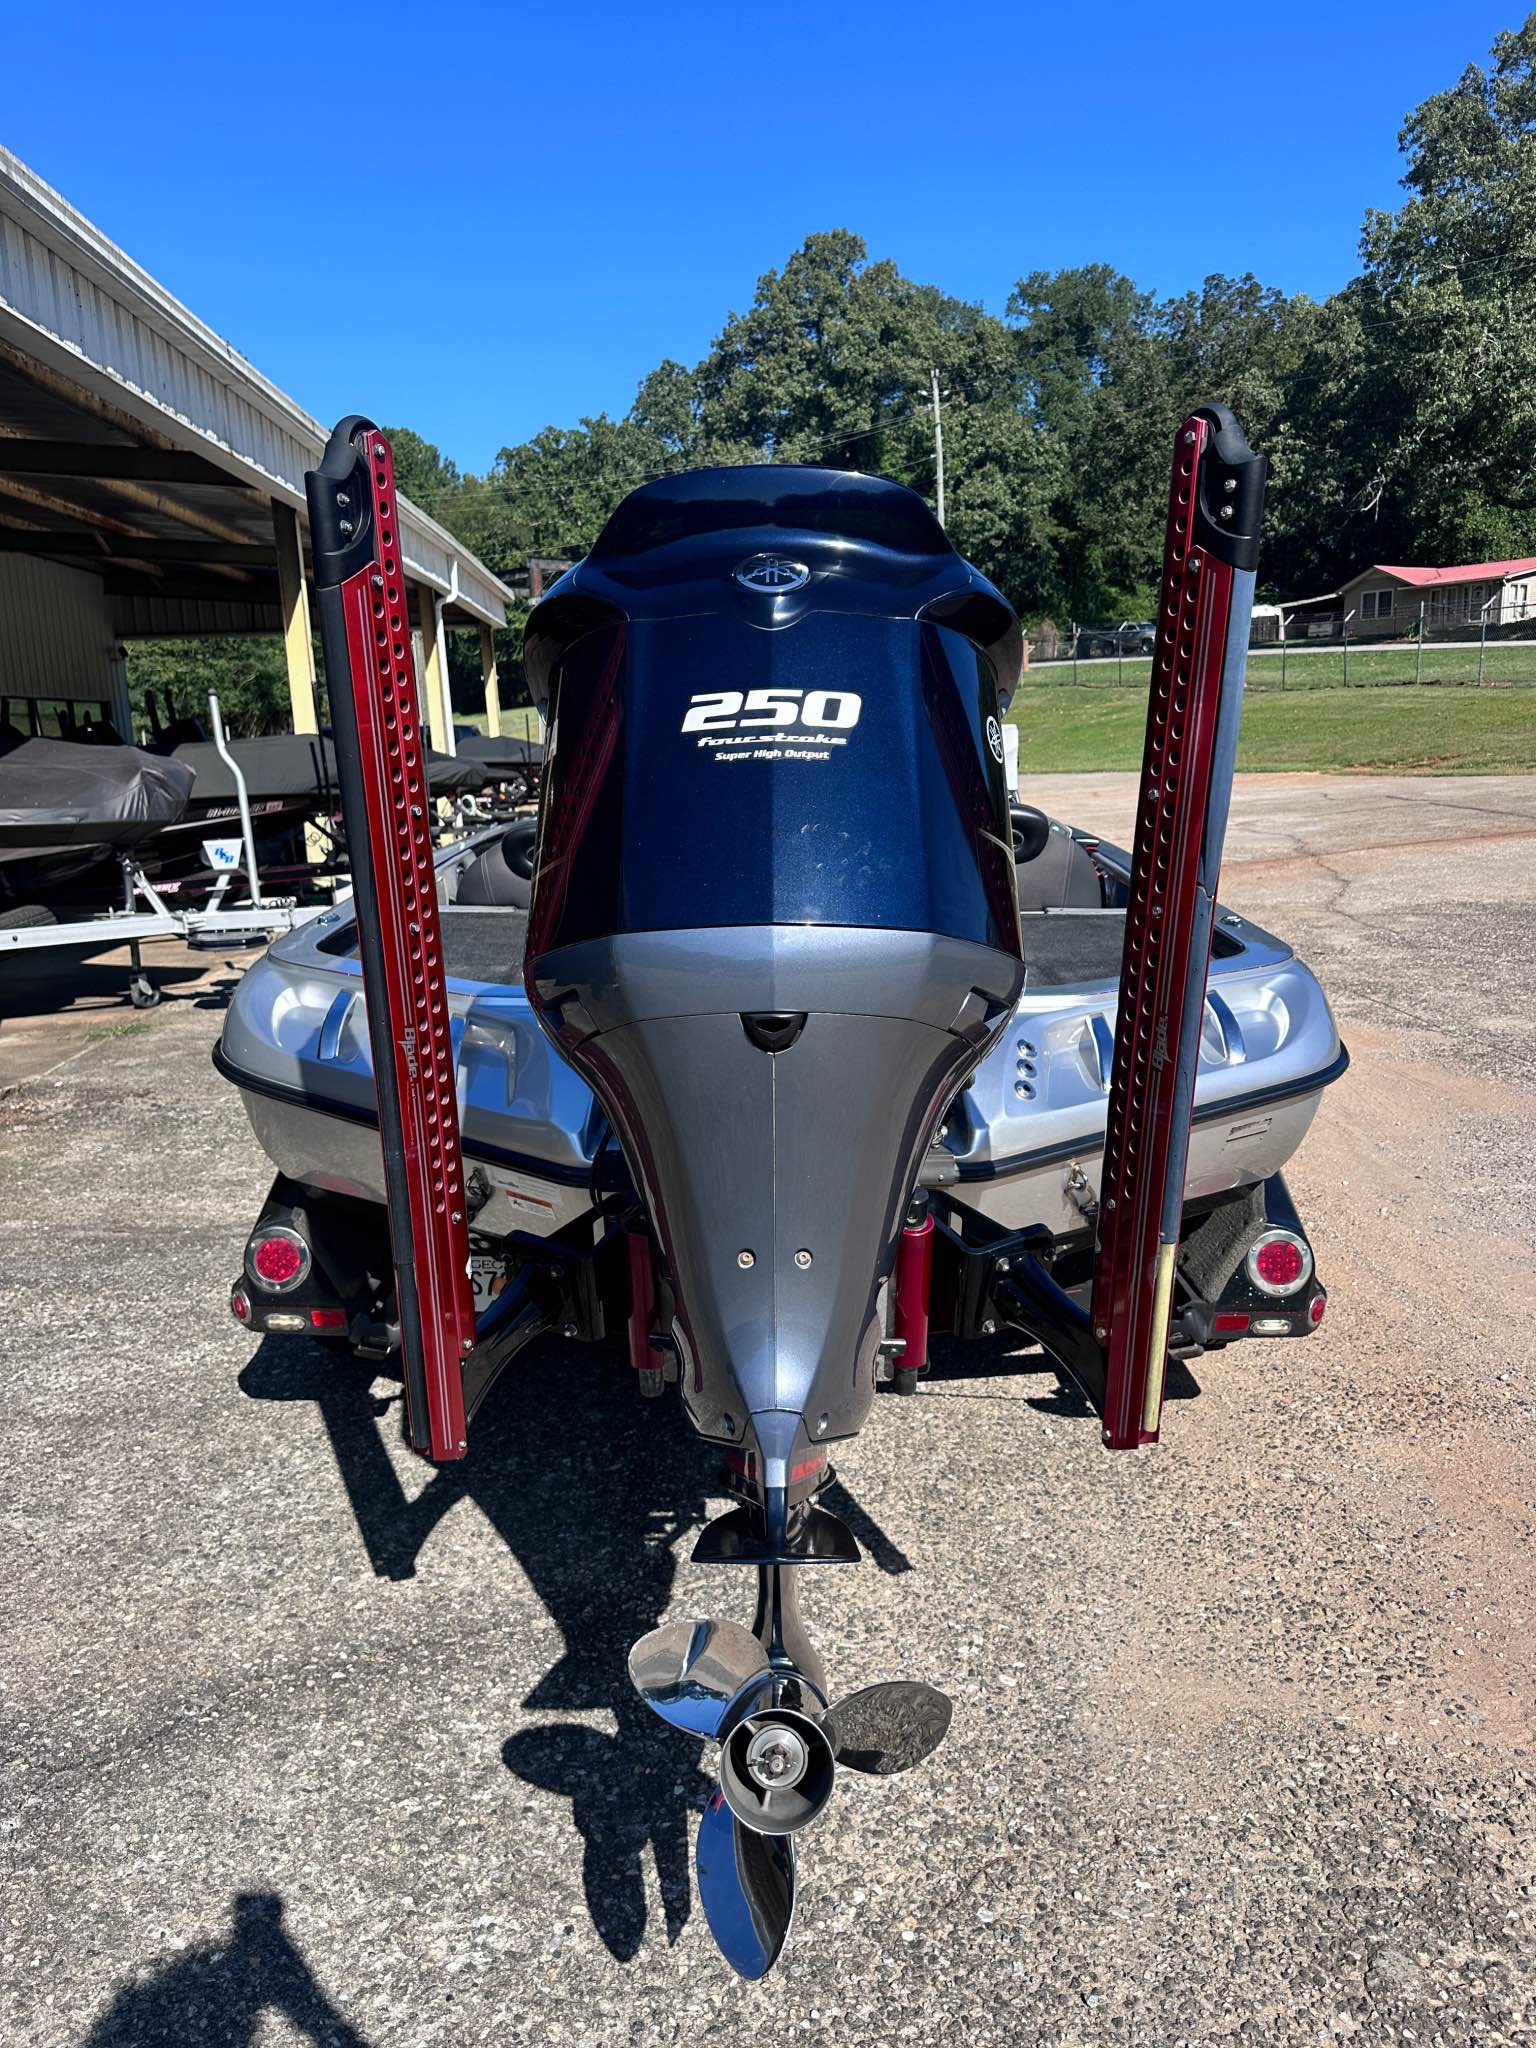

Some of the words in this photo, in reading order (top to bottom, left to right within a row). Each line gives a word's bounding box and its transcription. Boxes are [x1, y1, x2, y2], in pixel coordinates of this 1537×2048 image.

[681, 689, 862, 732] 250
[714, 751, 752, 762] Super
[753, 749, 782, 759] High
[784, 749, 831, 761] Output
[397, 1027, 419, 1080] Blade
